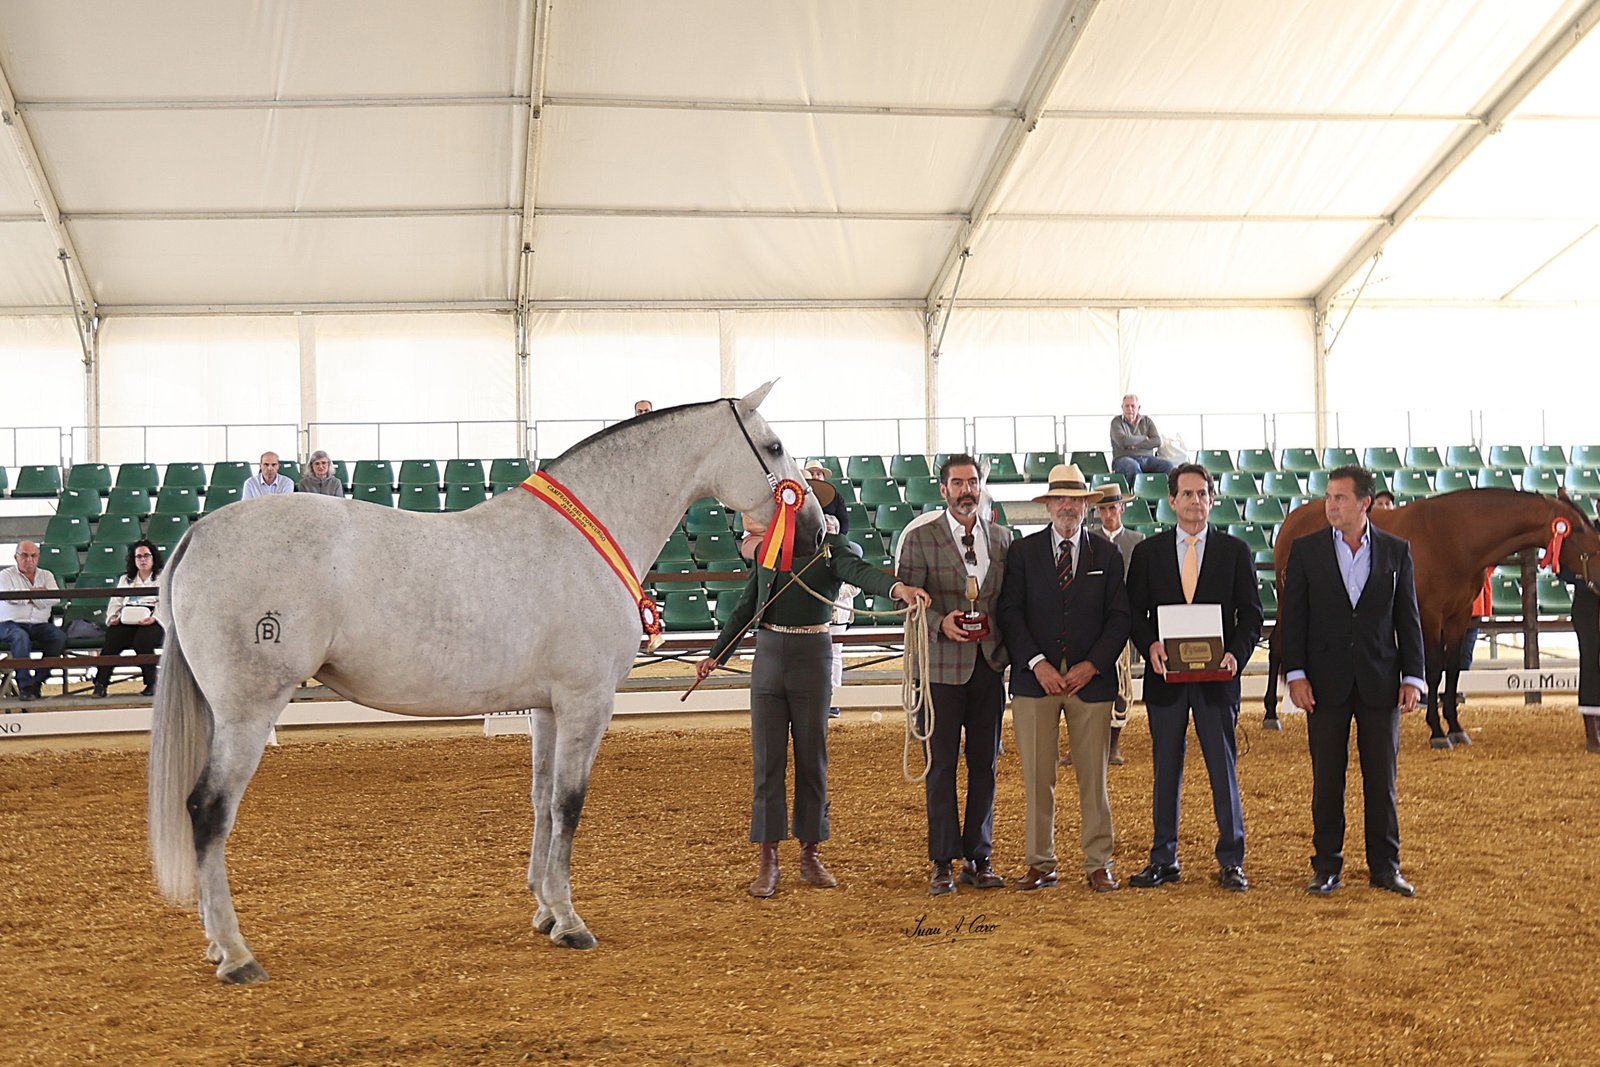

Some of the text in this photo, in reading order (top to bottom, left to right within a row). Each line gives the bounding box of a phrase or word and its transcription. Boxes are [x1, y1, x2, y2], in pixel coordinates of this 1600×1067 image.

[547, 485, 606, 541] CAMPEONA DEL CONCURSO
[560, 503, 576, 517] JEREZ
